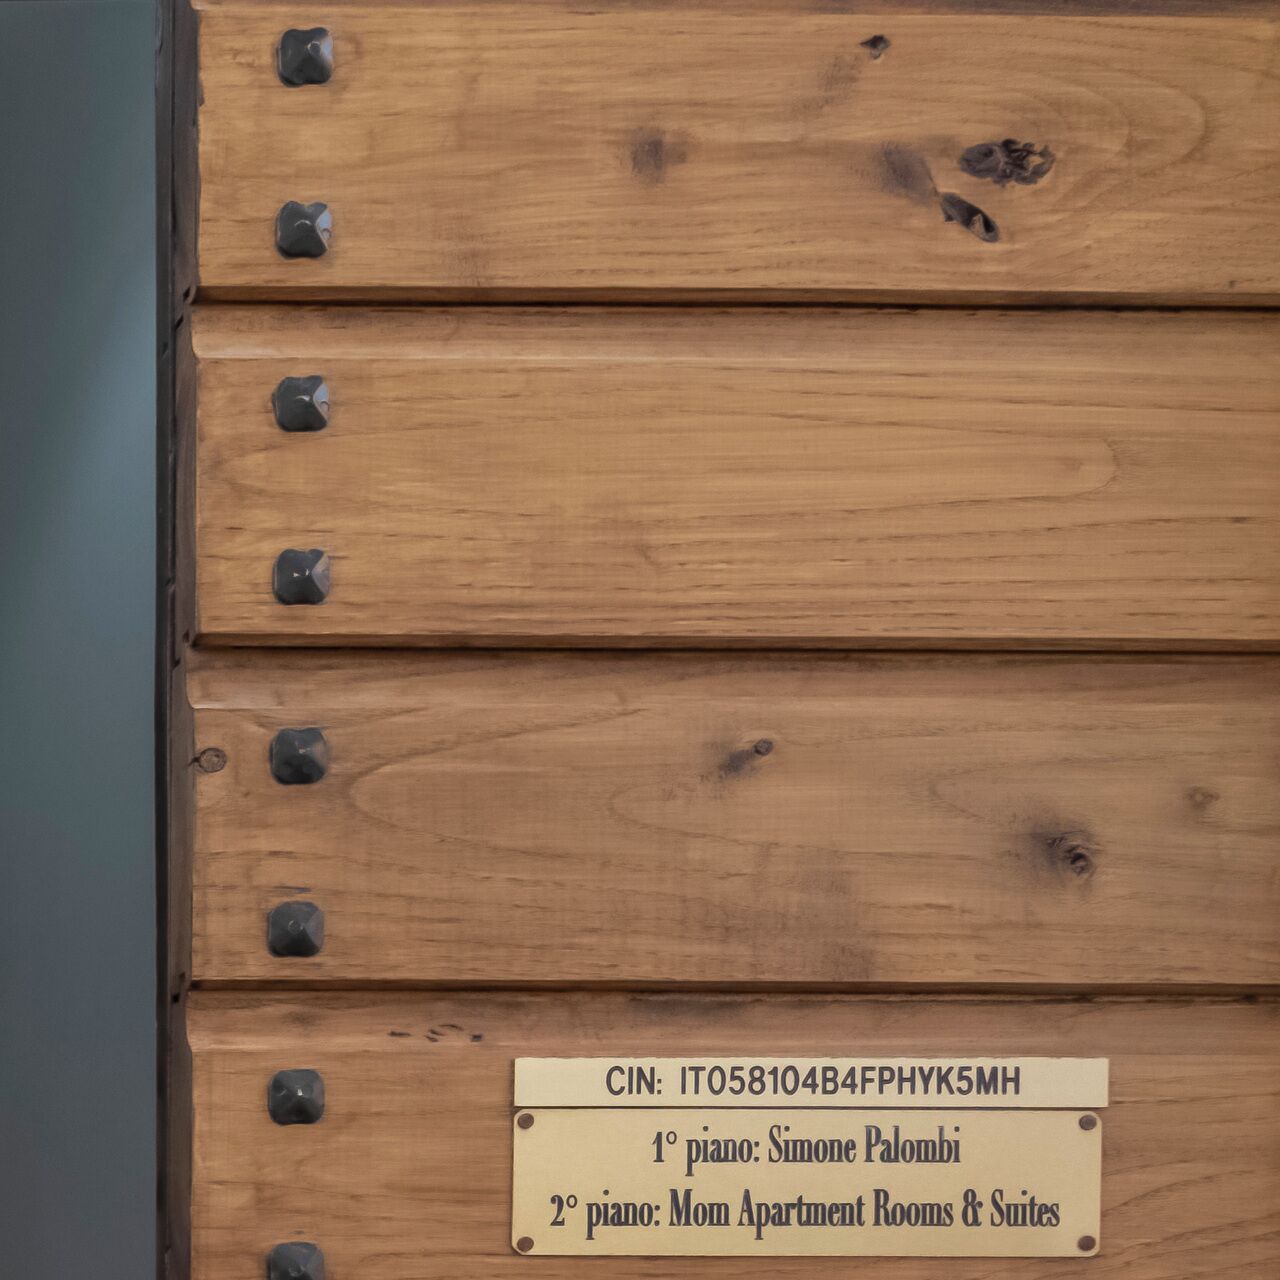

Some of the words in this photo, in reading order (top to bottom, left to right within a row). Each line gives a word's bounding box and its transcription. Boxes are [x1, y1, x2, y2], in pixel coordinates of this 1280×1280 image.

[605, 1065, 663, 1096] CIN:
[680, 1064, 1021, 1096] IT058104B4FPHYK5MH
[684, 1126, 760, 1177] piano:
[767, 1125, 857, 1164] Simone
[863, 1125, 961, 1164] Palombi
[585, 1189, 661, 1240] piano:
[667, 1189, 731, 1228] Mom
[737, 1189, 867, 1240] Apartment
[871, 1189, 955, 1228] Rooms
[961, 1189, 984, 1228] &
[990, 1189, 1061, 1228] Suites
